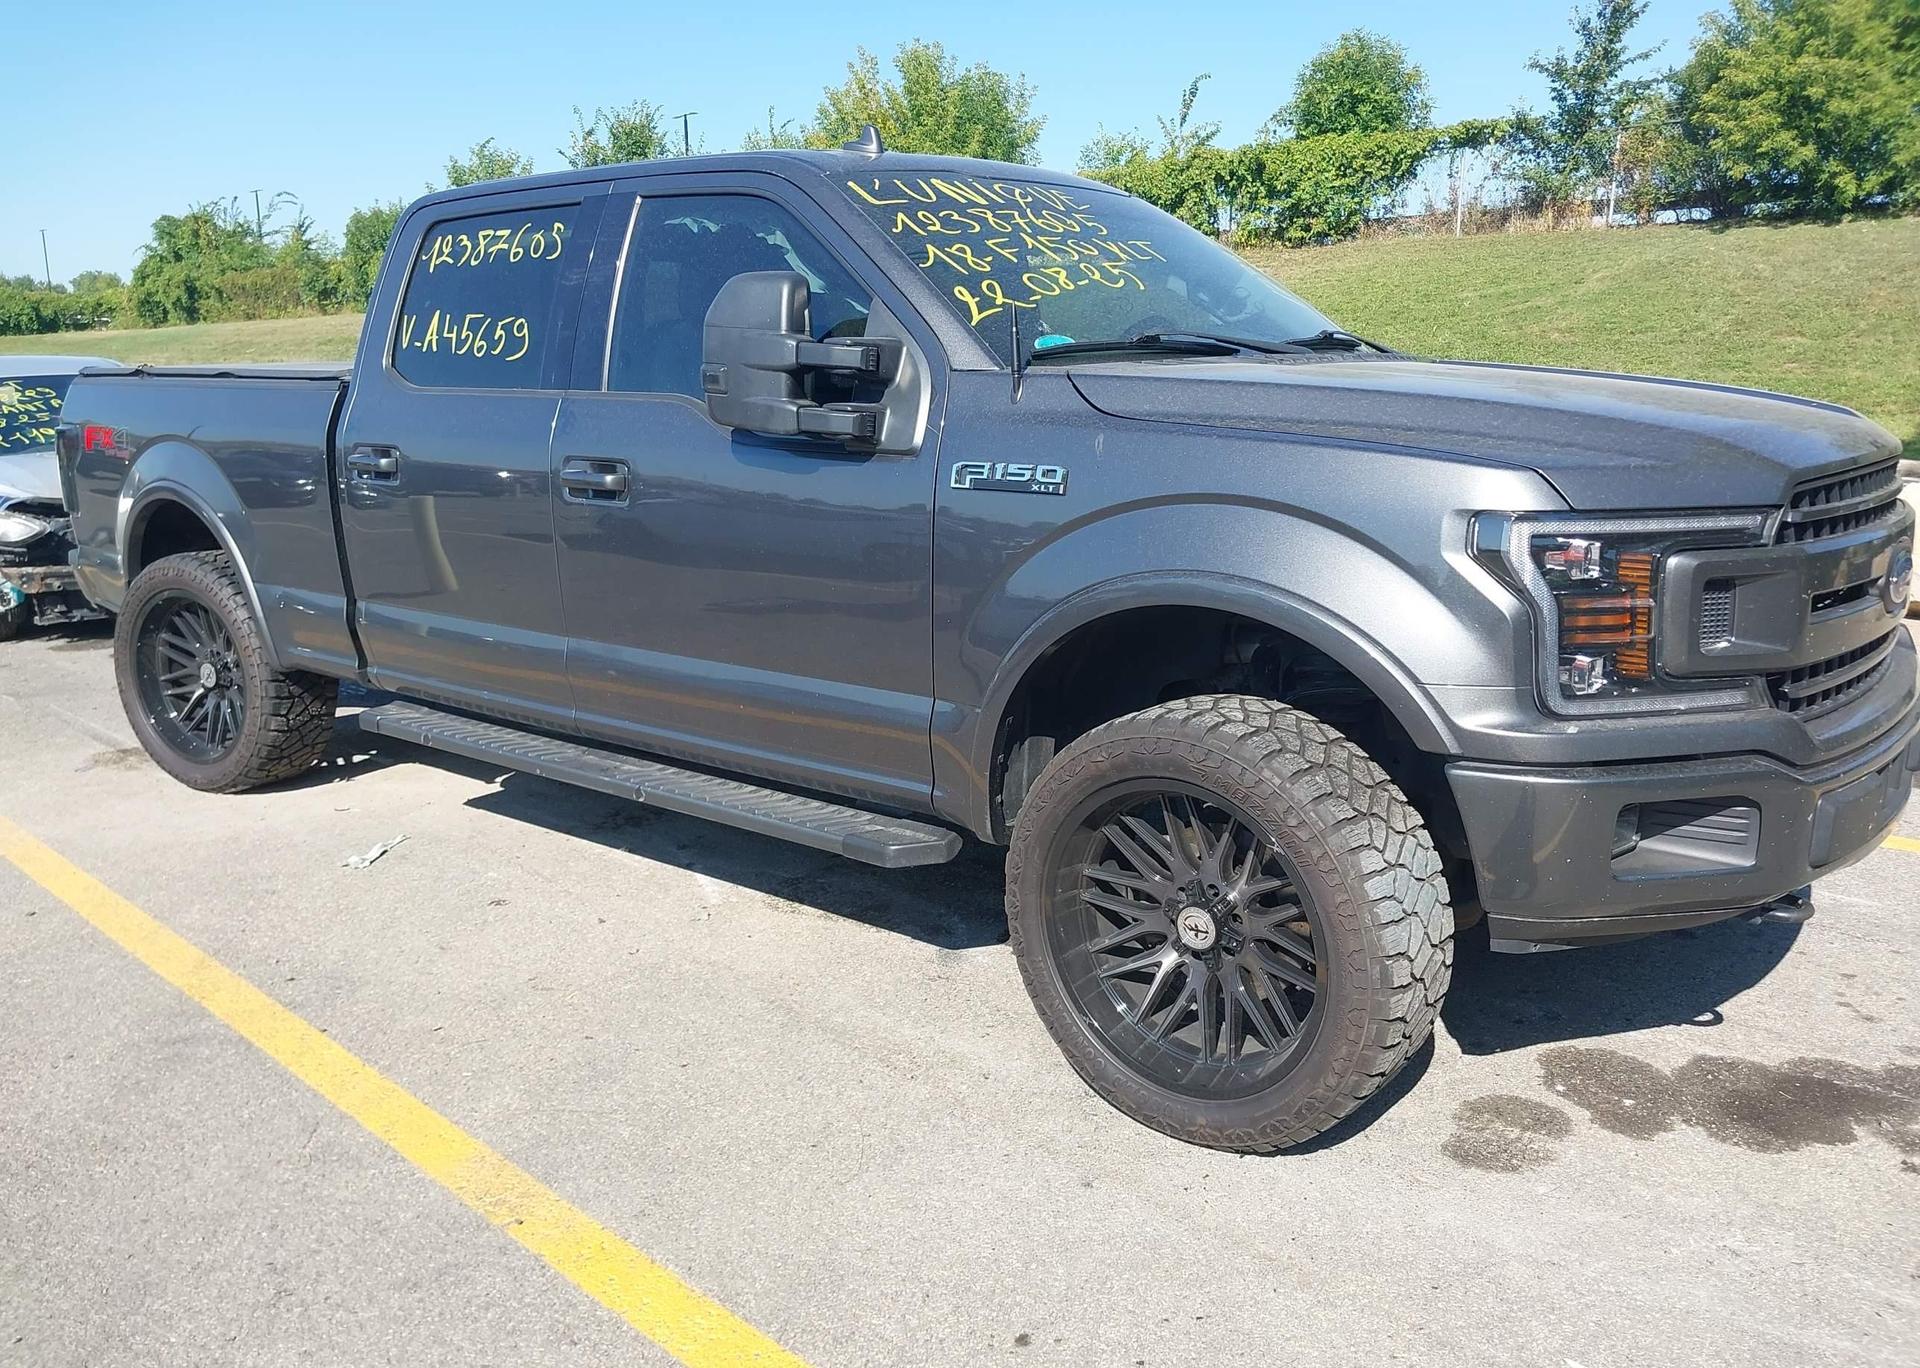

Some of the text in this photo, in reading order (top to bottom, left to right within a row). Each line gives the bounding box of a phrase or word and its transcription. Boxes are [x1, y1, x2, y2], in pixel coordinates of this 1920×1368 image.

[892, 207, 1108, 236] 12387605
[421, 222, 565, 274] 12387605
[84, 424, 129, 454] FX4
[1031, 484, 1056, 493] XLT
